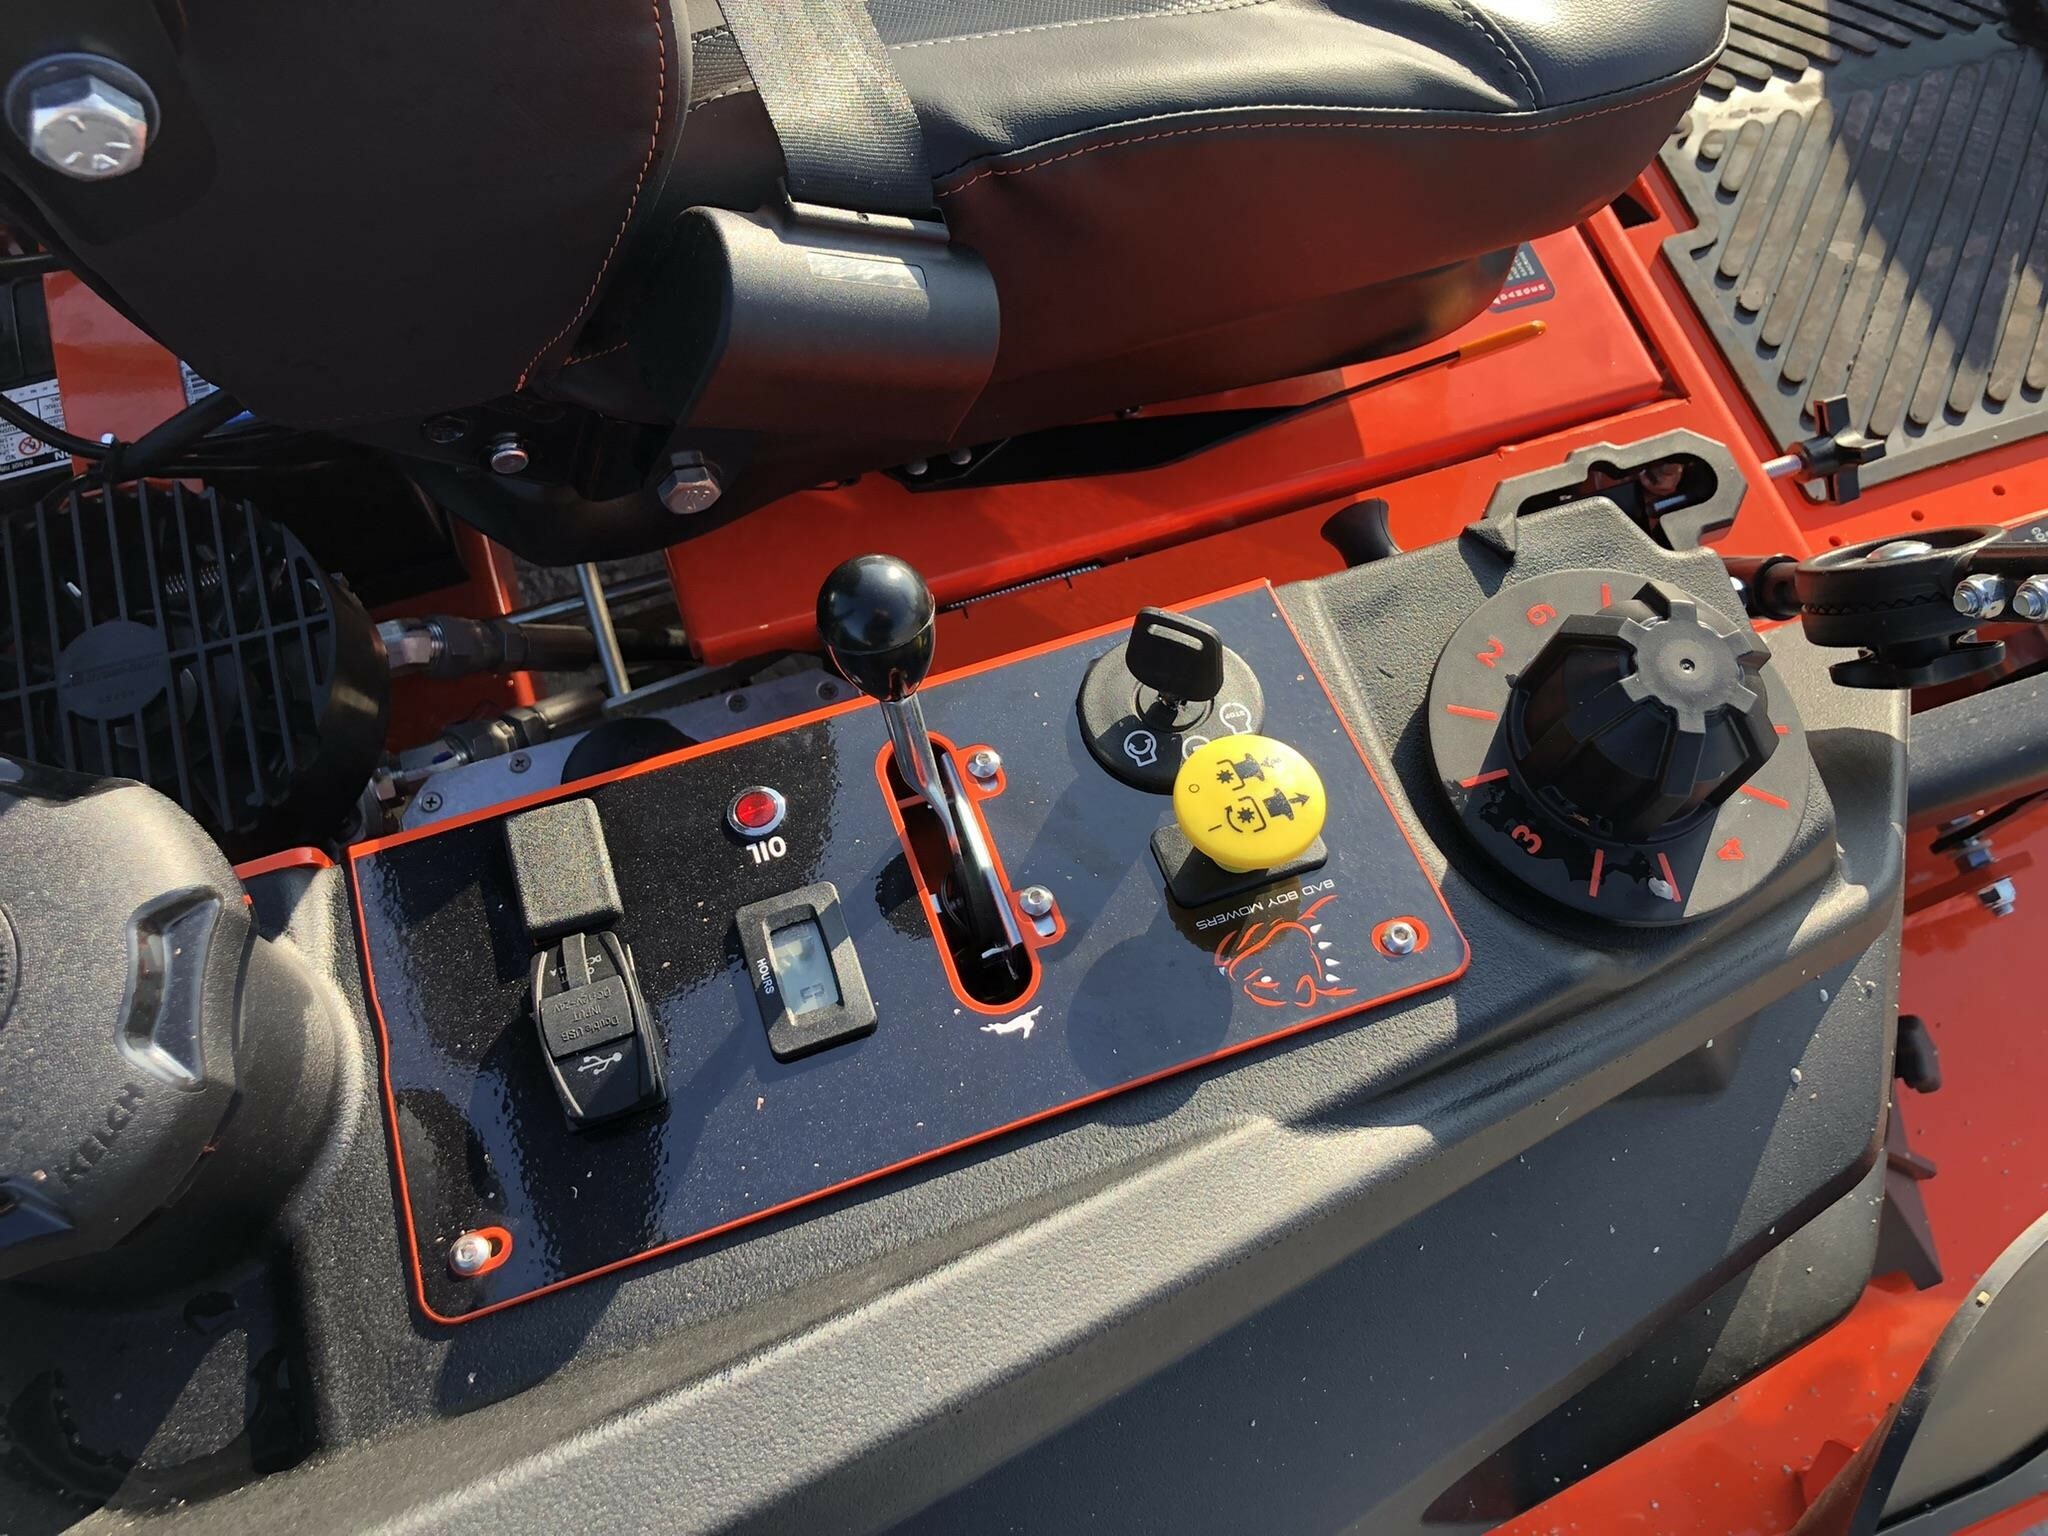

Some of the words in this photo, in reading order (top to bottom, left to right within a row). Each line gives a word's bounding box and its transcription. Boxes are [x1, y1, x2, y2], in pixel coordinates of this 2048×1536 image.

[1500, 283, 1546, 301] DANGER
[1475, 635, 1505, 668] 2
[746, 835, 787, 864] OIL
[1511, 824, 1543, 856] 3
[1268, 889, 1299, 908] BOY
[1302, 879, 1336, 896] BAD
[1195, 901, 1264, 930] MOWERS
[756, 957, 775, 995] HOURS
[573, 1005, 601, 1023] INPUT
[561, 1026, 584, 1042] USB
